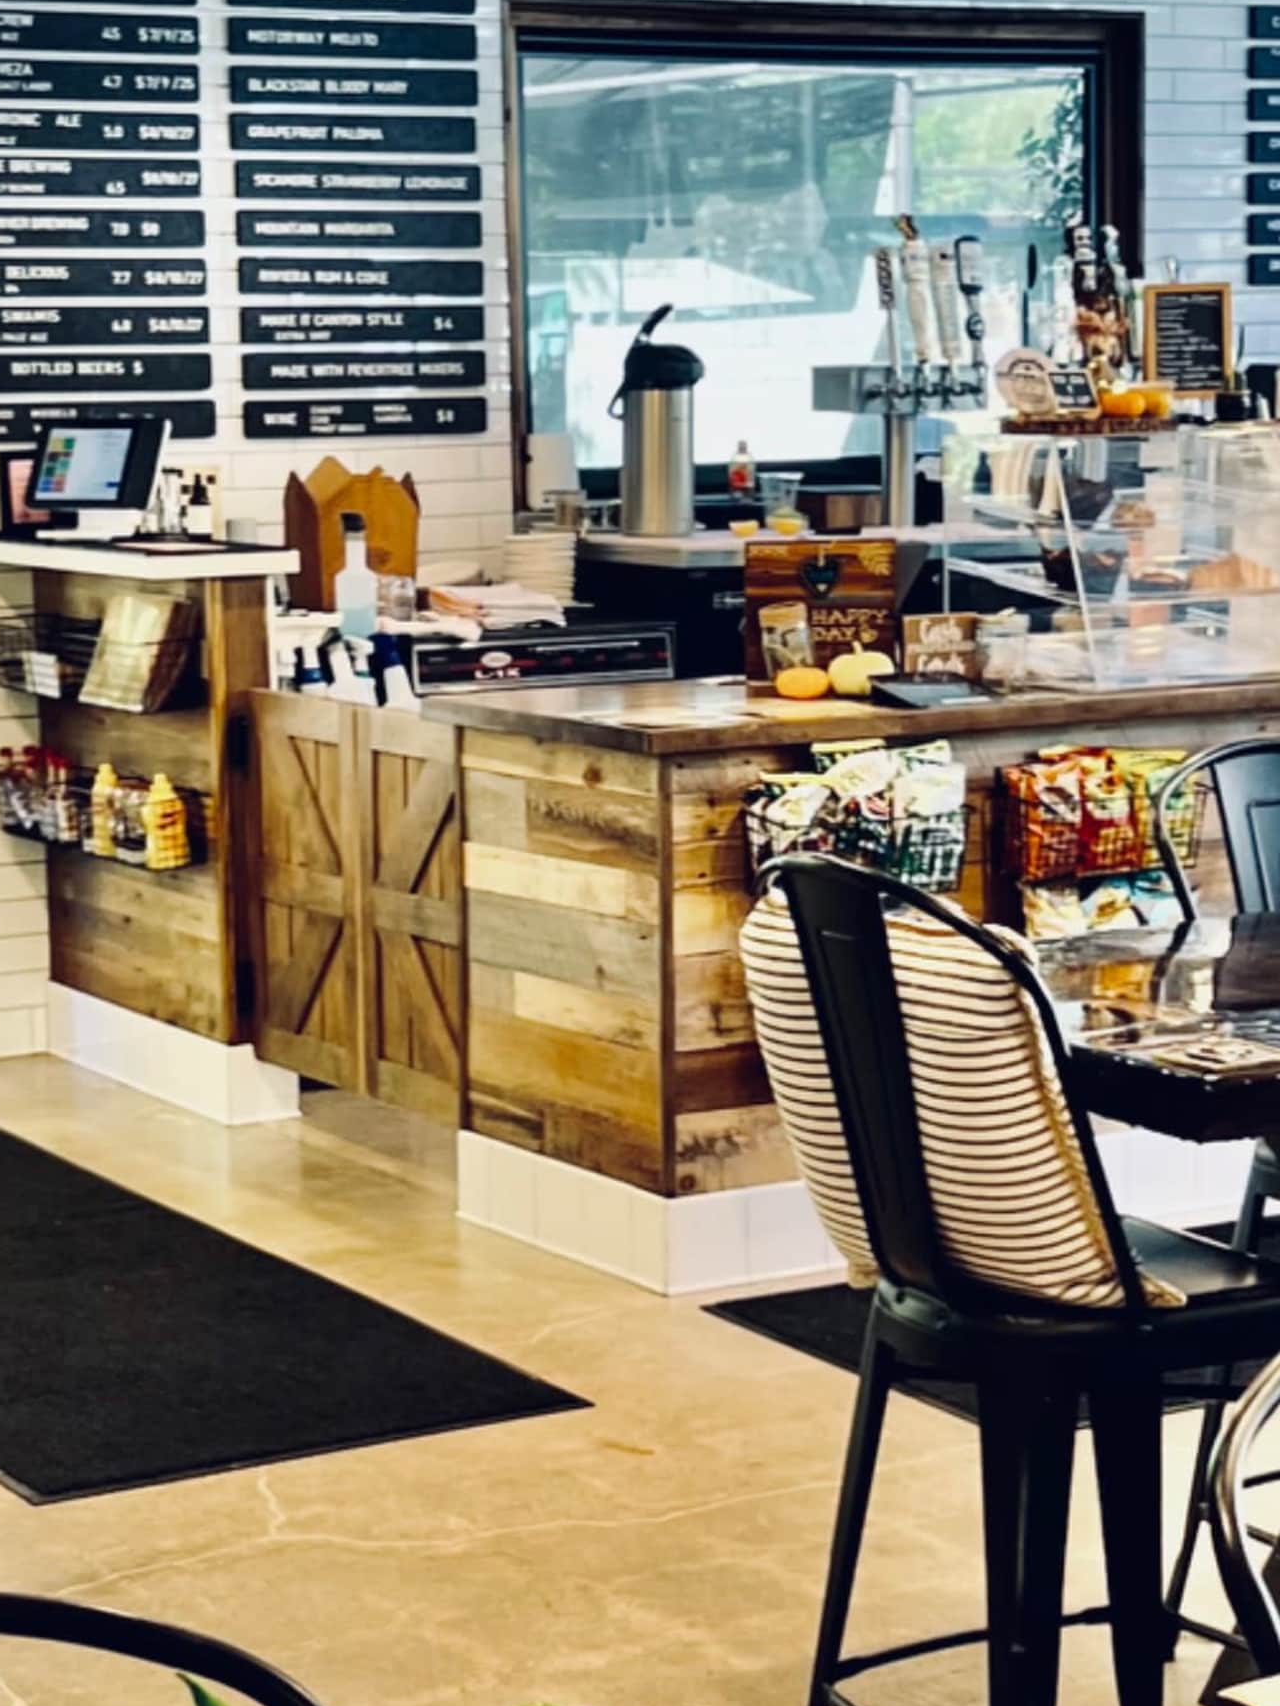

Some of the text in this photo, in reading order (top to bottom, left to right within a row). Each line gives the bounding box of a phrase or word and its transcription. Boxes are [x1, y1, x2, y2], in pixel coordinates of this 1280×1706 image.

[246, 29, 325, 45] MOTORWAY
[55, 113, 83, 128] ALE
[259, 313, 298, 328] MAKE
[366, 312, 405, 327] STYLE
[10, 360, 75, 376] BOTTLED
[77, 360, 126, 376] BEERS
[270, 364, 309, 379] MADE
[311, 363, 345, 377] WITH
[263, 411, 298, 426] WINE
[811, 607, 889, 625] HAPPY
[813, 627, 856, 642] DAY
